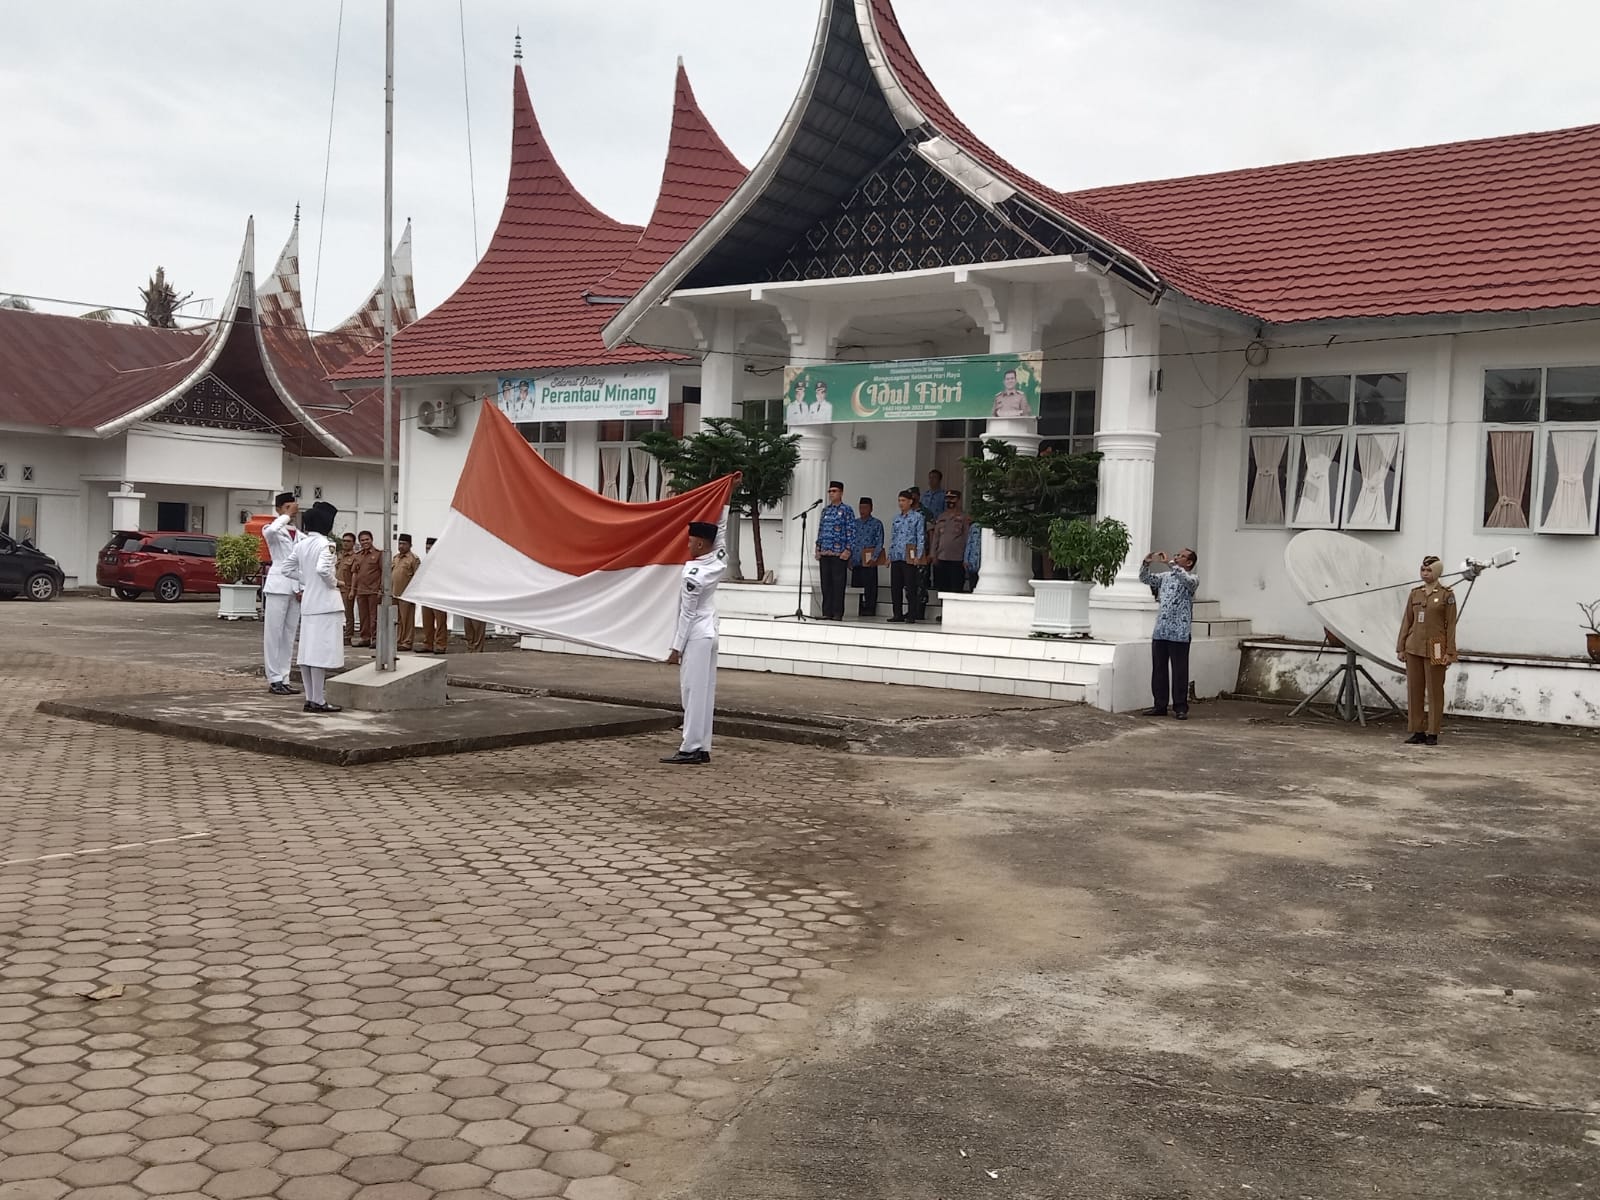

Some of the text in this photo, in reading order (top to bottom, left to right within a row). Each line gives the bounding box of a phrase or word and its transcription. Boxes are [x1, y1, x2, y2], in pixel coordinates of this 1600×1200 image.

[550, 376, 579, 388] Selamat
[541, 384, 657, 405] Perantau Minang
[867, 381, 963, 405] Idul Fitri
